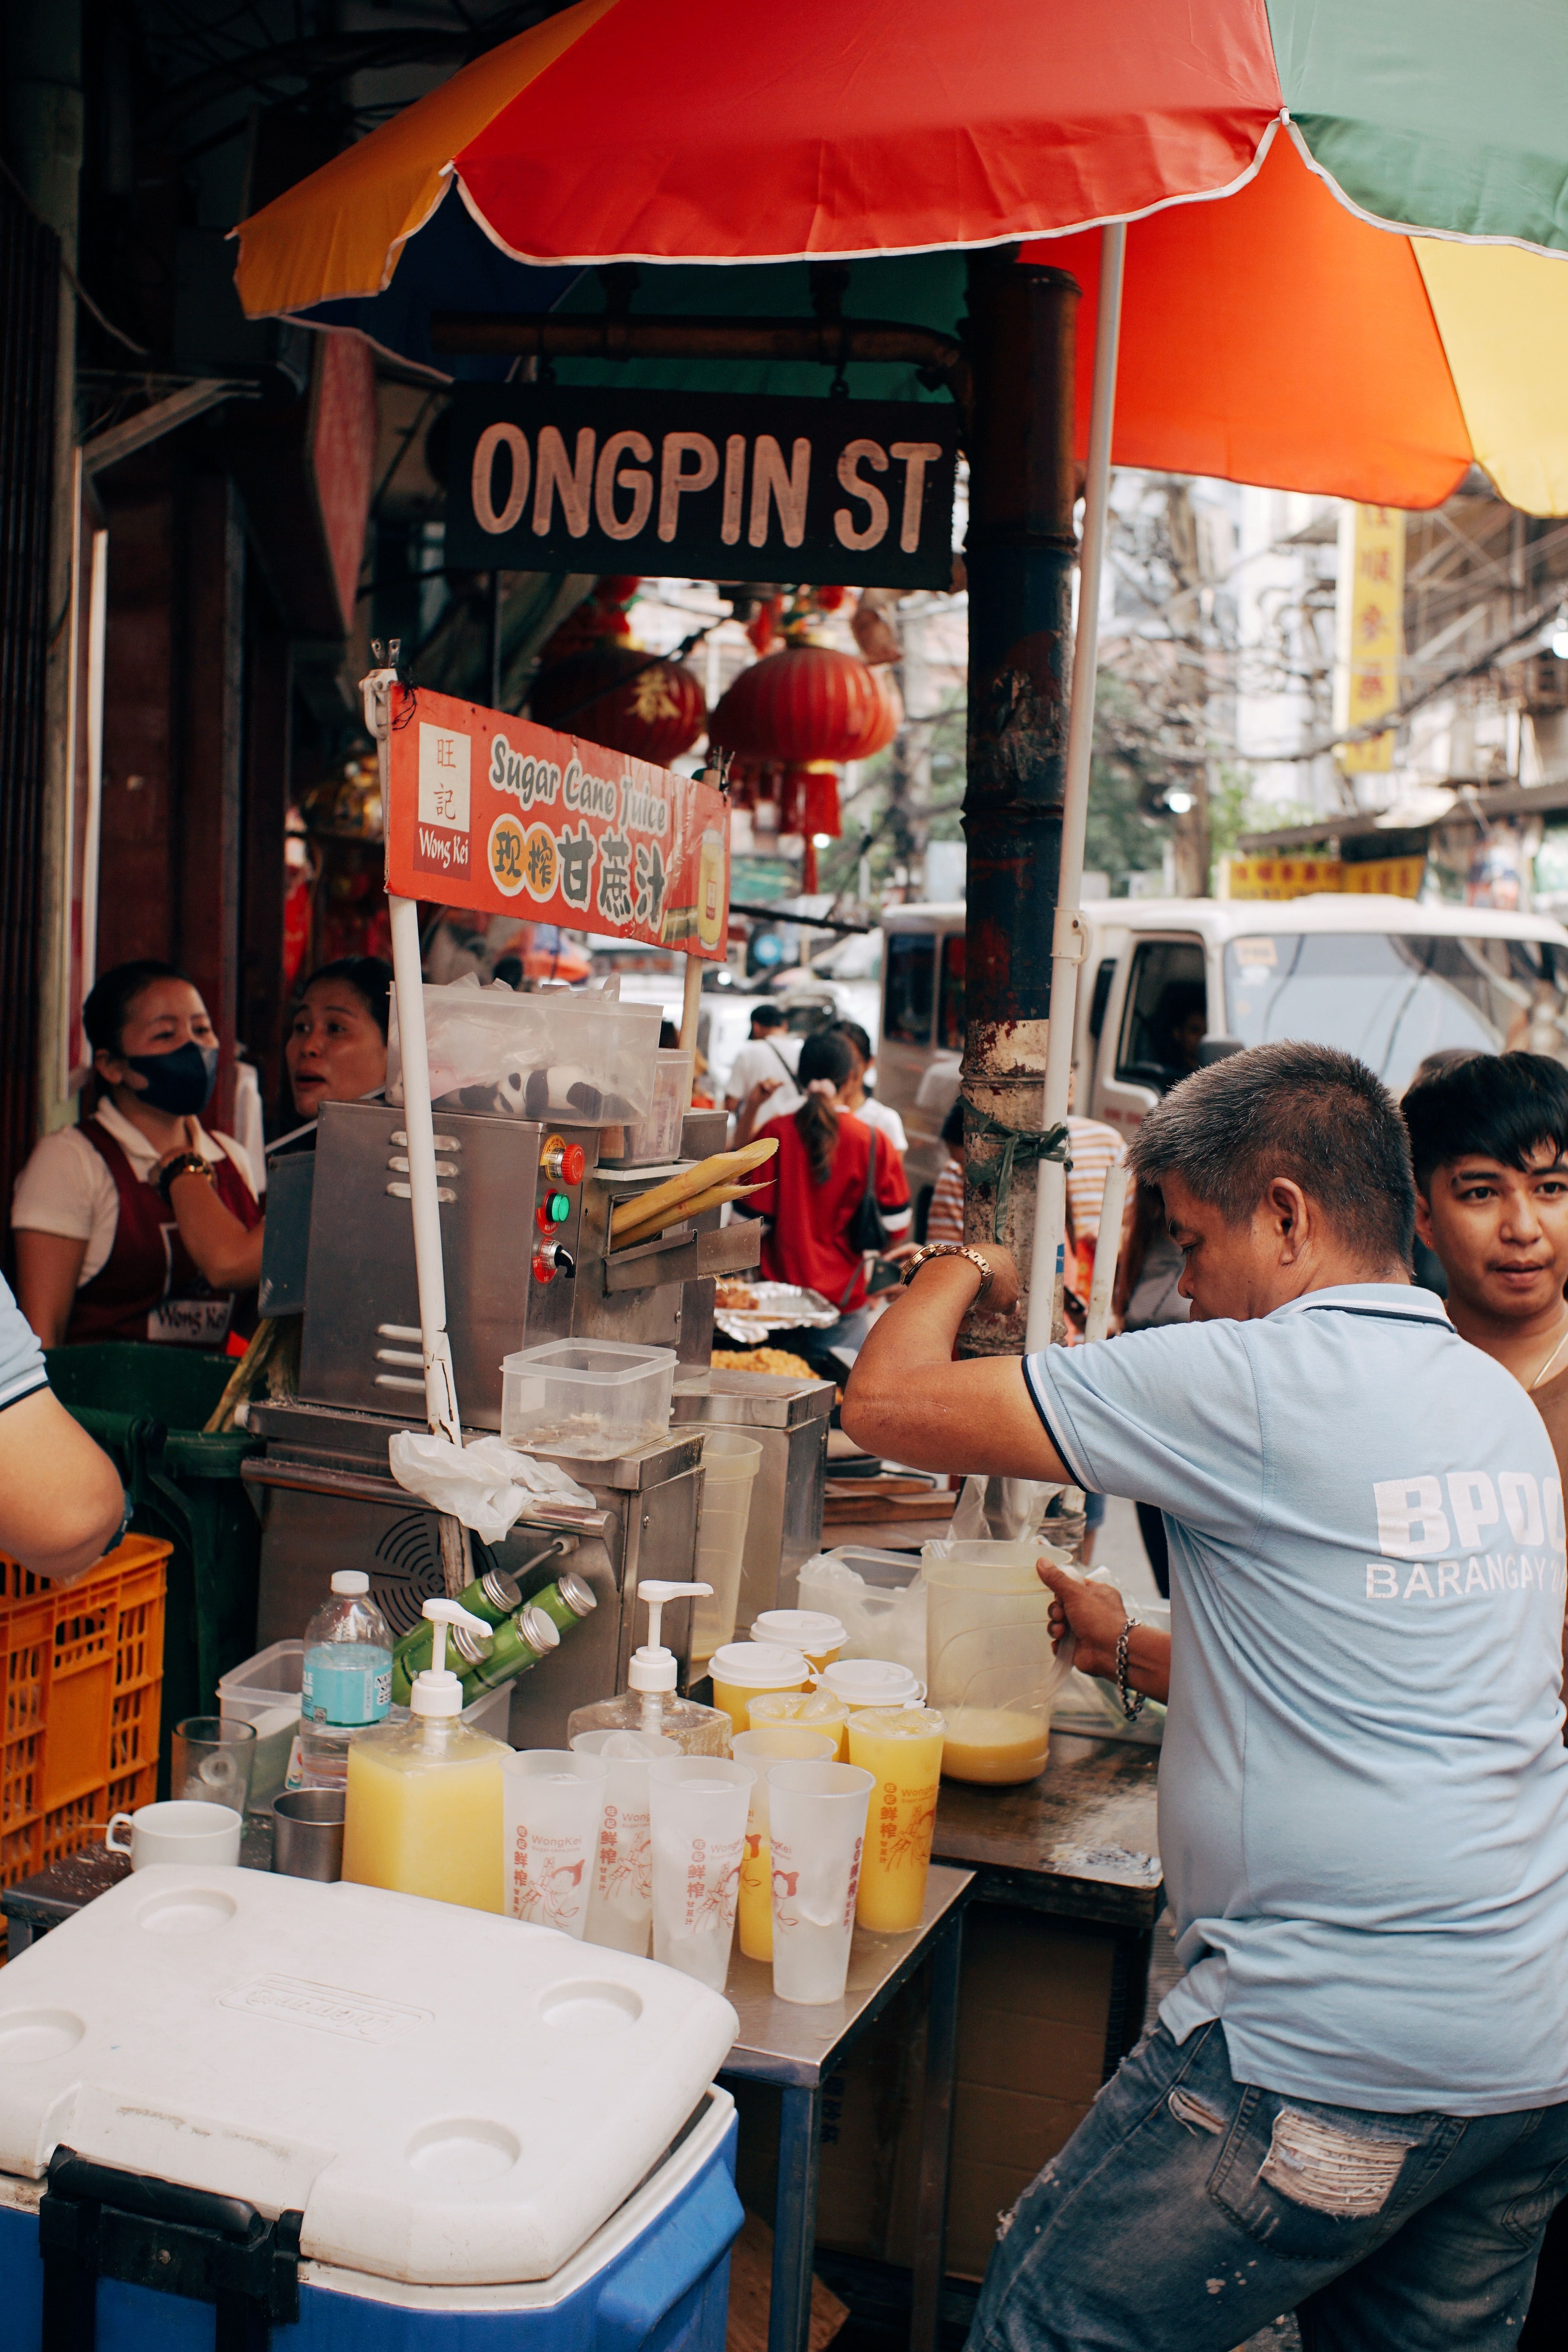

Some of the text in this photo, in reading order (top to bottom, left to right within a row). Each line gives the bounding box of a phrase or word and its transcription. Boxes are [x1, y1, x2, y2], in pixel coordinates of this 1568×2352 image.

[472, 422, 942, 554] ONGPIN ST
[434, 739, 457, 820] 旺記
[492, 740, 665, 831] Sugar Cane Juice
[419, 827, 469, 869] Wong Kei
[494, 824, 665, 924] 现榨甘蔗汁
[1366, 1553, 1546, 1599] BARANGAY
[622, 1813, 650, 1822] Wong
[532, 1835, 582, 1848] WongKei
[274, 1996, 396, 2035] Coleman
